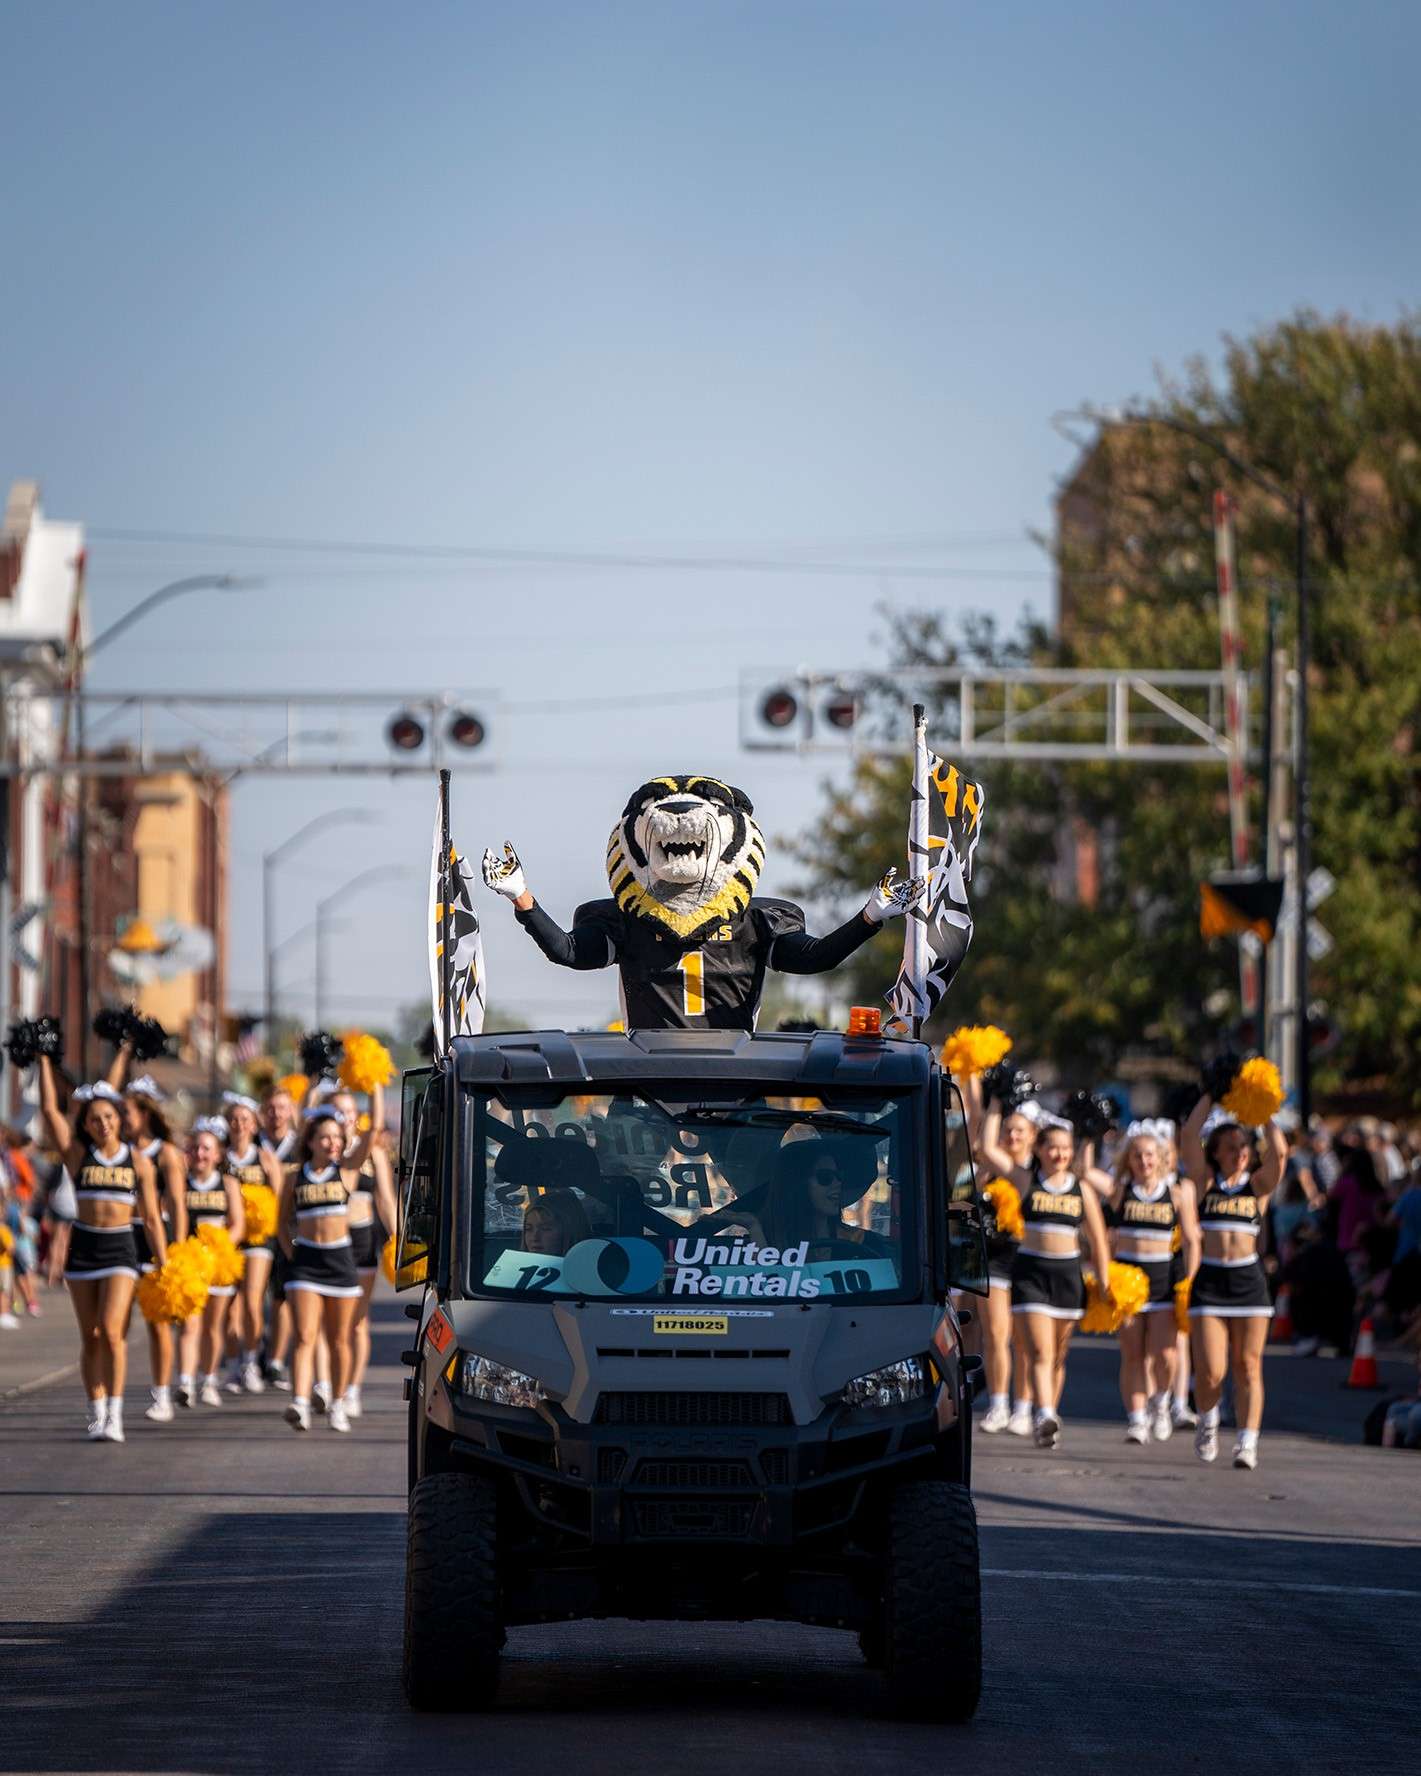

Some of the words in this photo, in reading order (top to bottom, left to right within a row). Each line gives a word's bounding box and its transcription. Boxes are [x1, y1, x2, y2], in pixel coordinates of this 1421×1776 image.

[676, 951, 705, 1016] 1
[81, 1166, 135, 1189] TIGERS
[186, 1190, 226, 1212] IGERS
[1032, 1191, 1081, 1217] TIGERS
[673, 1238, 810, 1267] United
[514, 1265, 561, 1290] 12
[672, 1267, 820, 1298] Rentals
[824, 1269, 872, 1293] 10
[656, 1320, 725, 1330] 11718025
